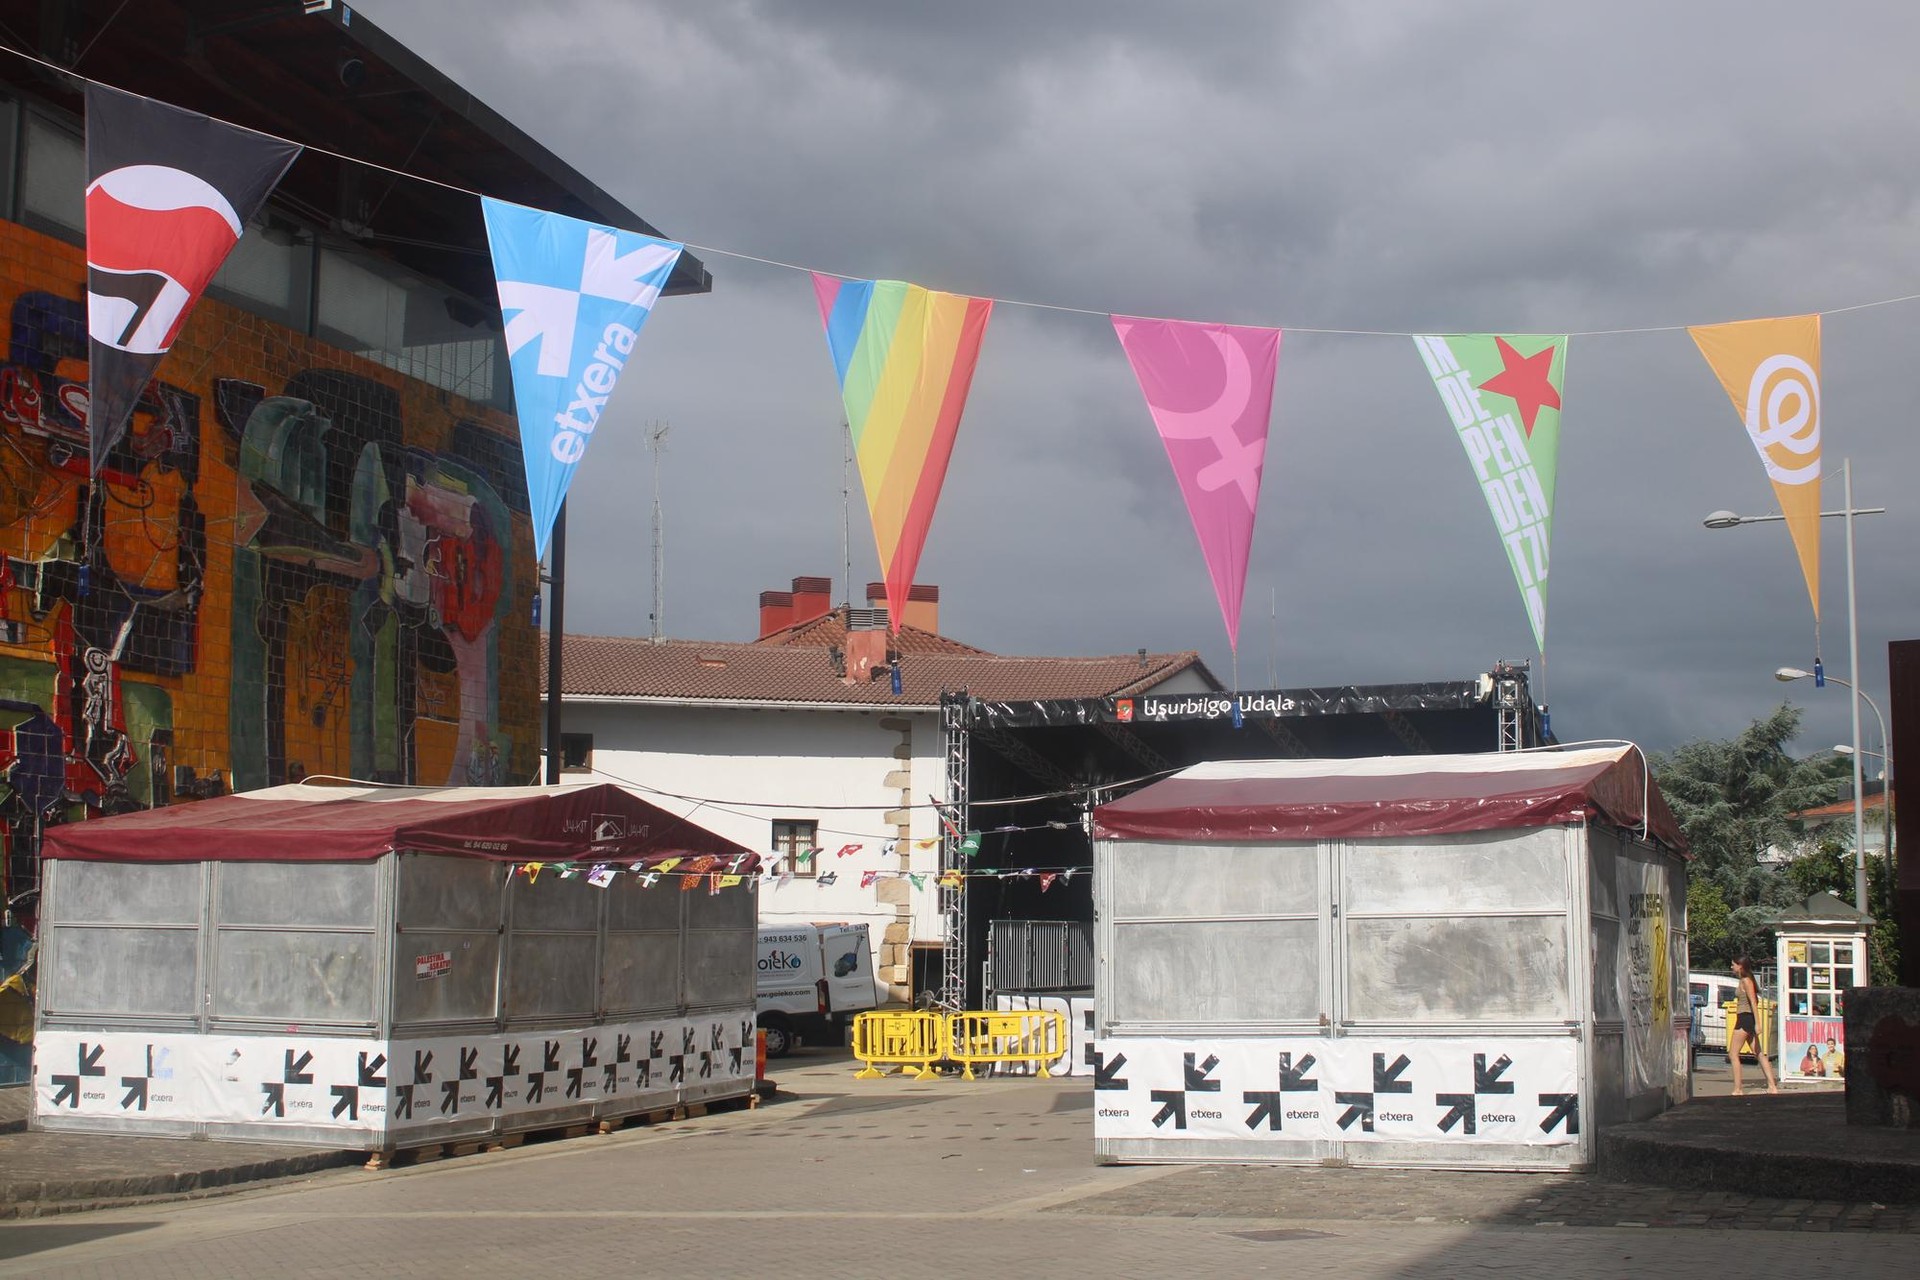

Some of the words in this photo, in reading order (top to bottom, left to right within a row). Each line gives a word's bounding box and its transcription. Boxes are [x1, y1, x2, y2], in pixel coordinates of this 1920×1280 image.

[551, 322, 638, 465] etxera
[1144, 698, 1231, 717] Usurbilgo
[1239, 695, 1293, 712] Udala
[763, 935, 777, 943] 943
[757, 951, 801, 970] oieko
[83, 1091, 106, 1100] etxera
[361, 1103, 386, 1112] etxera
[1098, 1107, 1129, 1117] etxera
[1190, 1109, 1222, 1119] etxera
[1286, 1109, 1319, 1119] etxera
[1379, 1112, 1413, 1122] etxera
[1481, 1113, 1516, 1123] etxera
